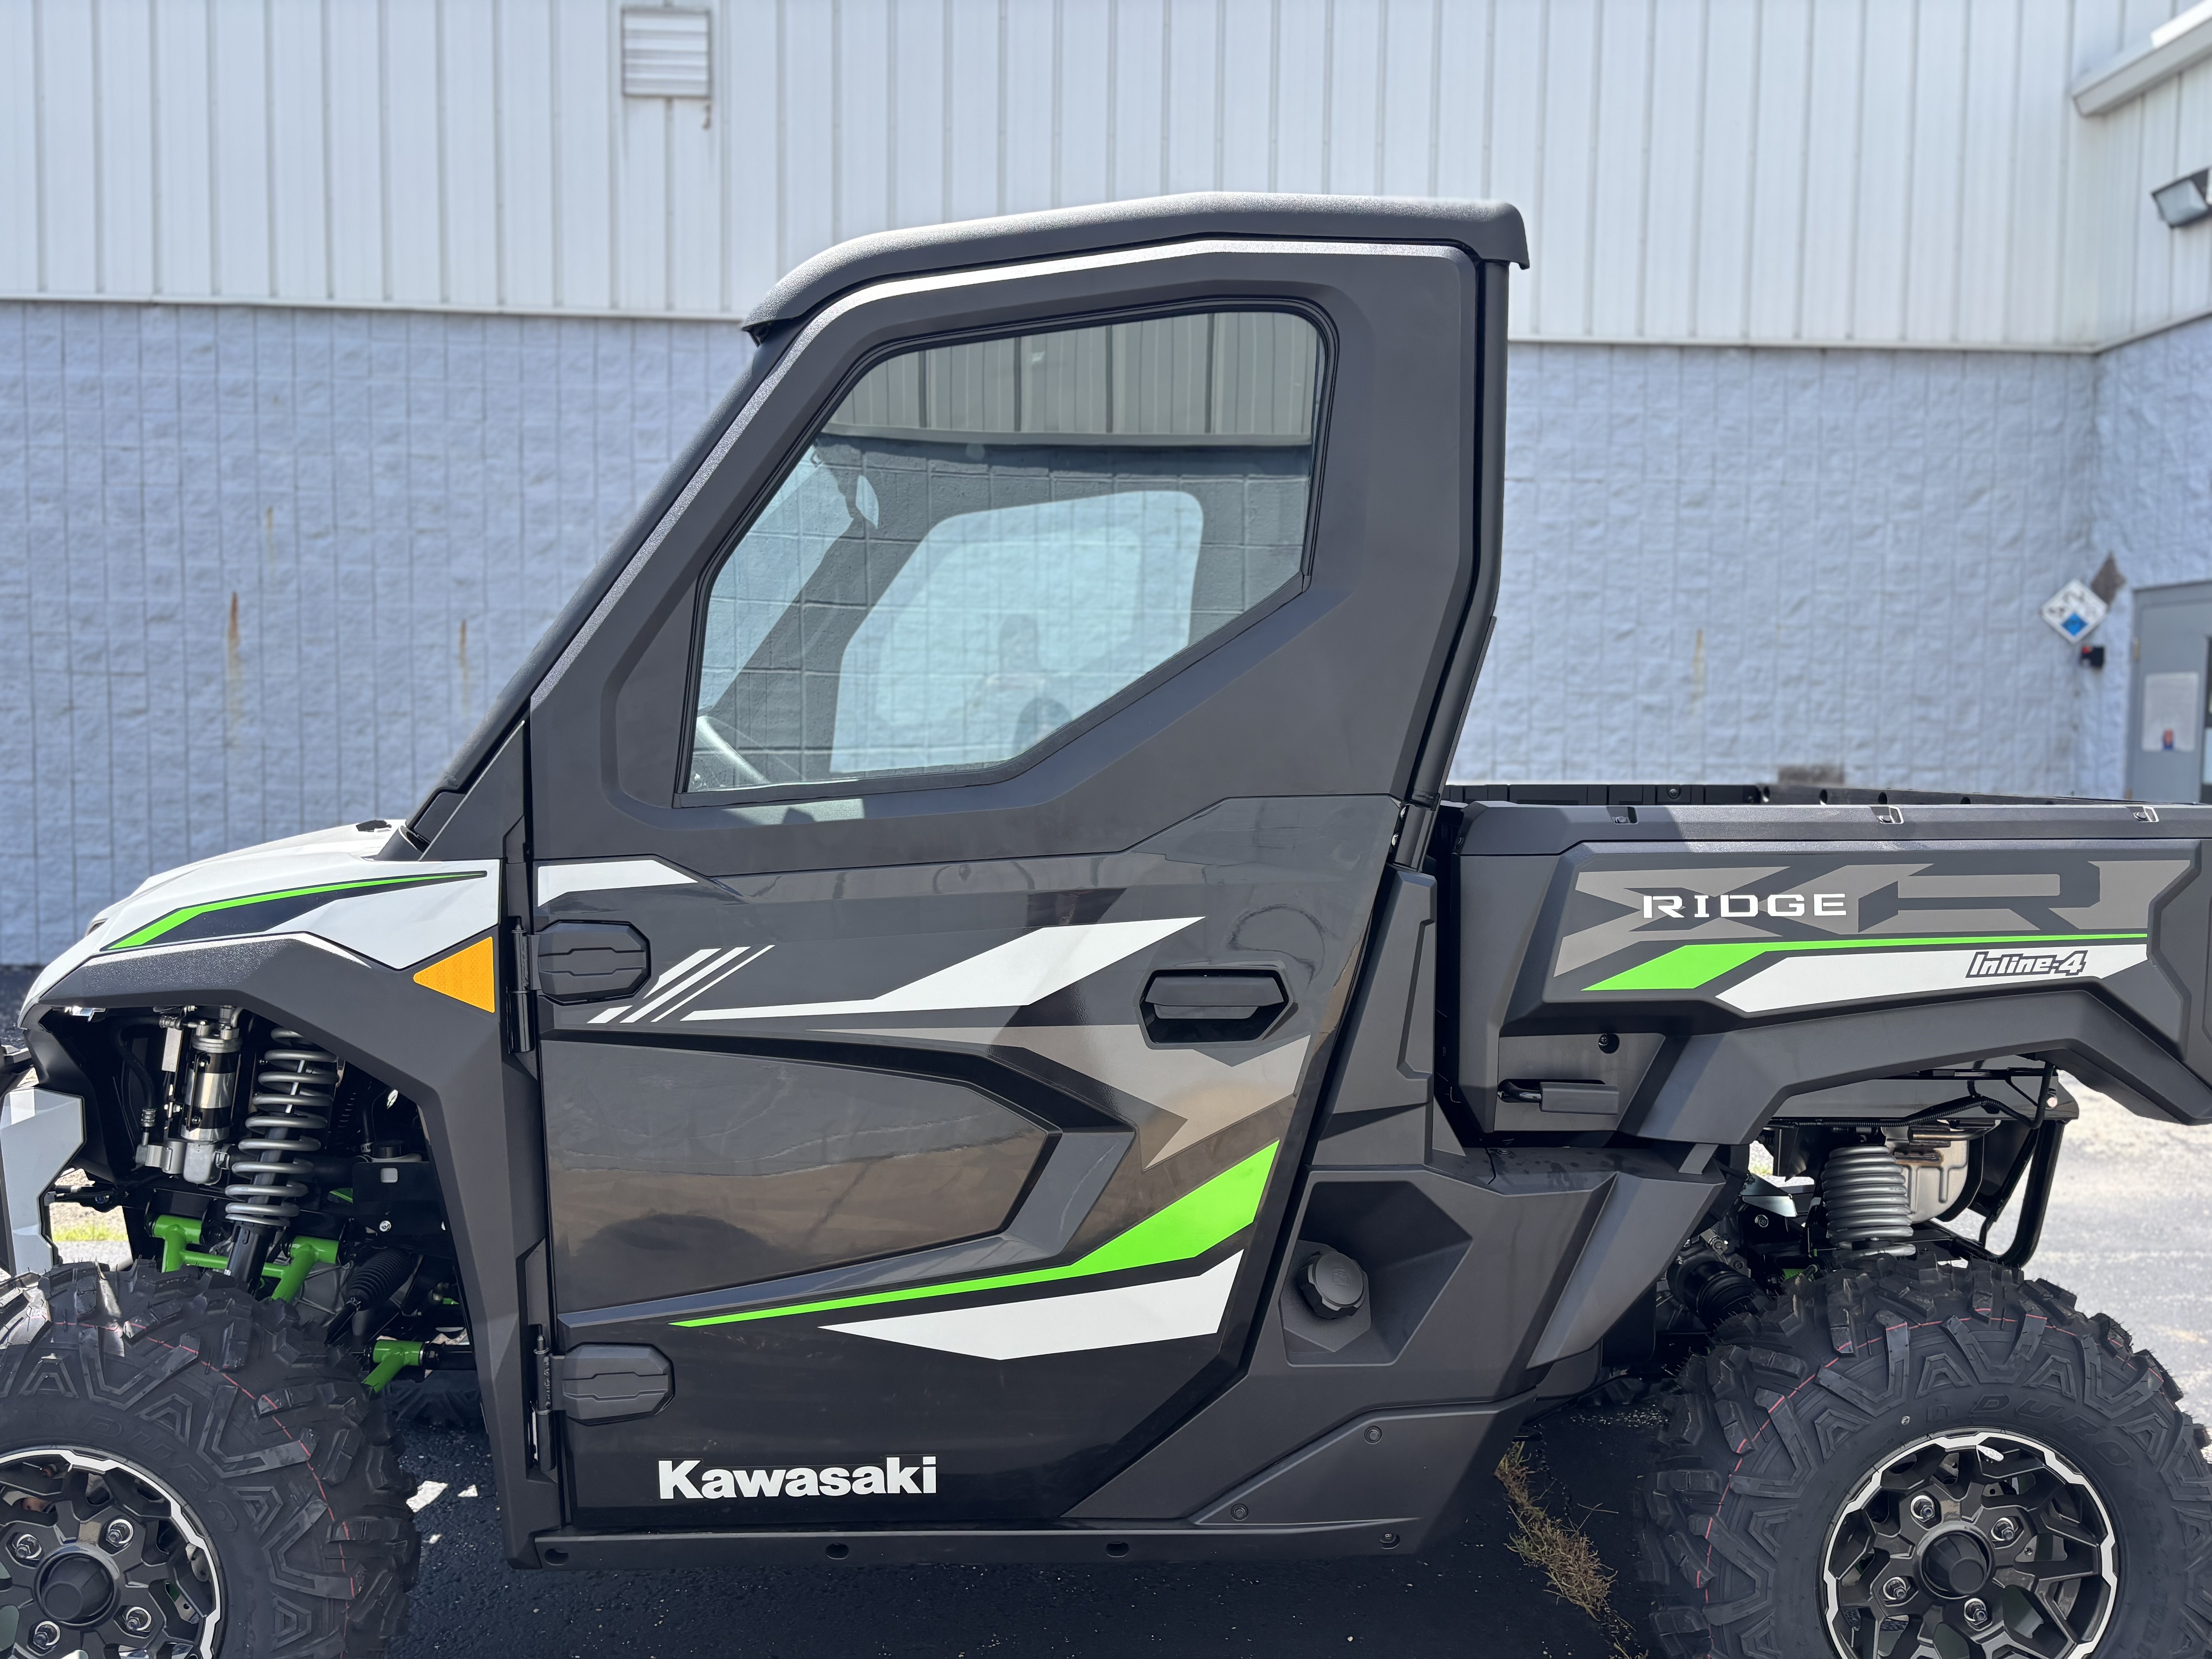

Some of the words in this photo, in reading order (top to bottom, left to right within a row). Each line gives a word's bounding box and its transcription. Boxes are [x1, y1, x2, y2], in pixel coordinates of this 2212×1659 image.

[1643, 893, 1846, 918] RIDGE
[1966, 950, 2088, 977] Inline-4
[1970, 1394, 2134, 1467] DURO
[84, 1416, 238, 1532] DURO
[659, 1456, 936, 1499] Kawasaki
